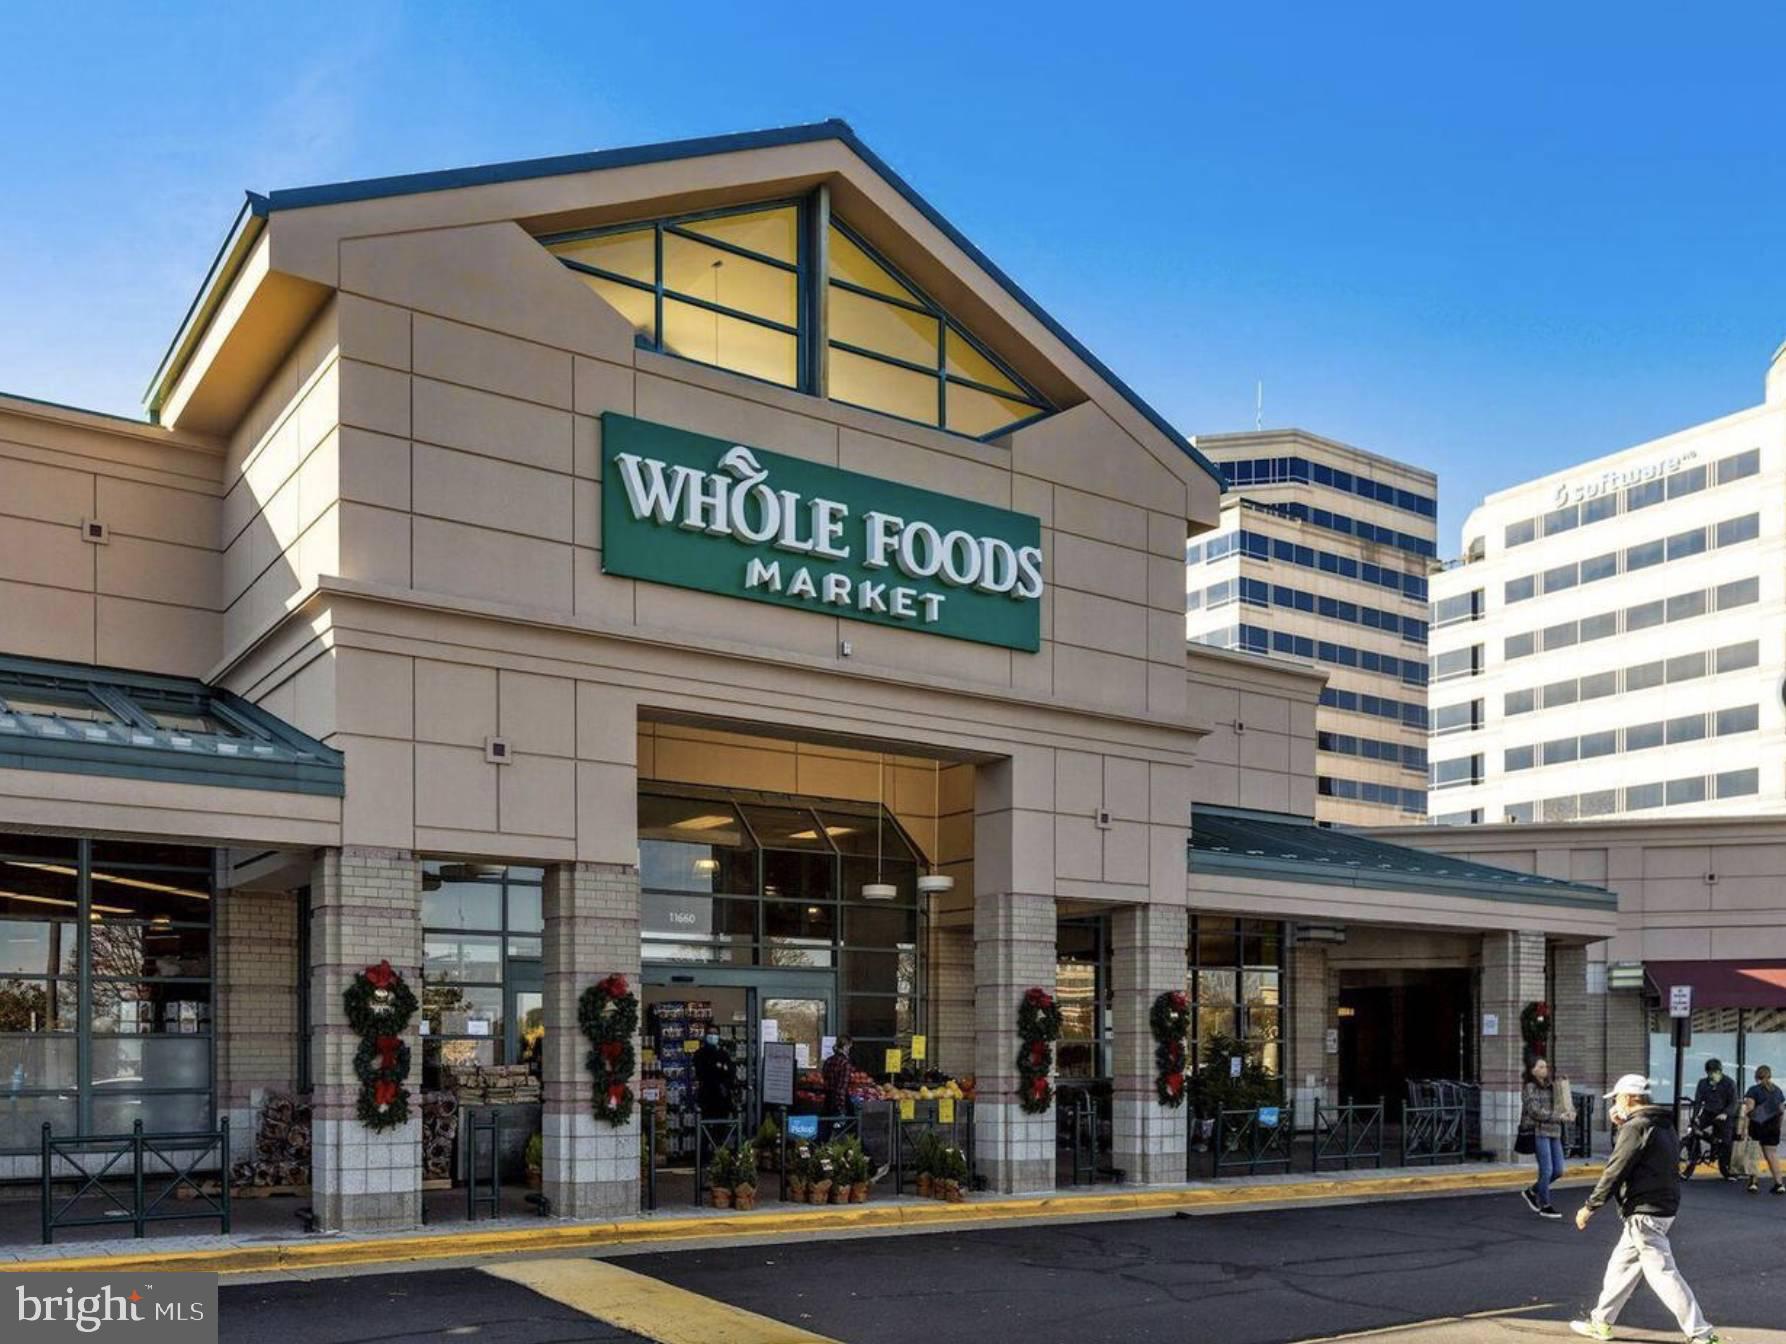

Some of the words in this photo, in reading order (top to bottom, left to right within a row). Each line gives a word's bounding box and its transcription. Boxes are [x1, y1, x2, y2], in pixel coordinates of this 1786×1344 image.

[614, 447, 850, 559] WHOLE
[862, 511, 1043, 599] FOODS
[745, 557, 946, 623] MARKET
[669, 912, 696, 924] 11660
